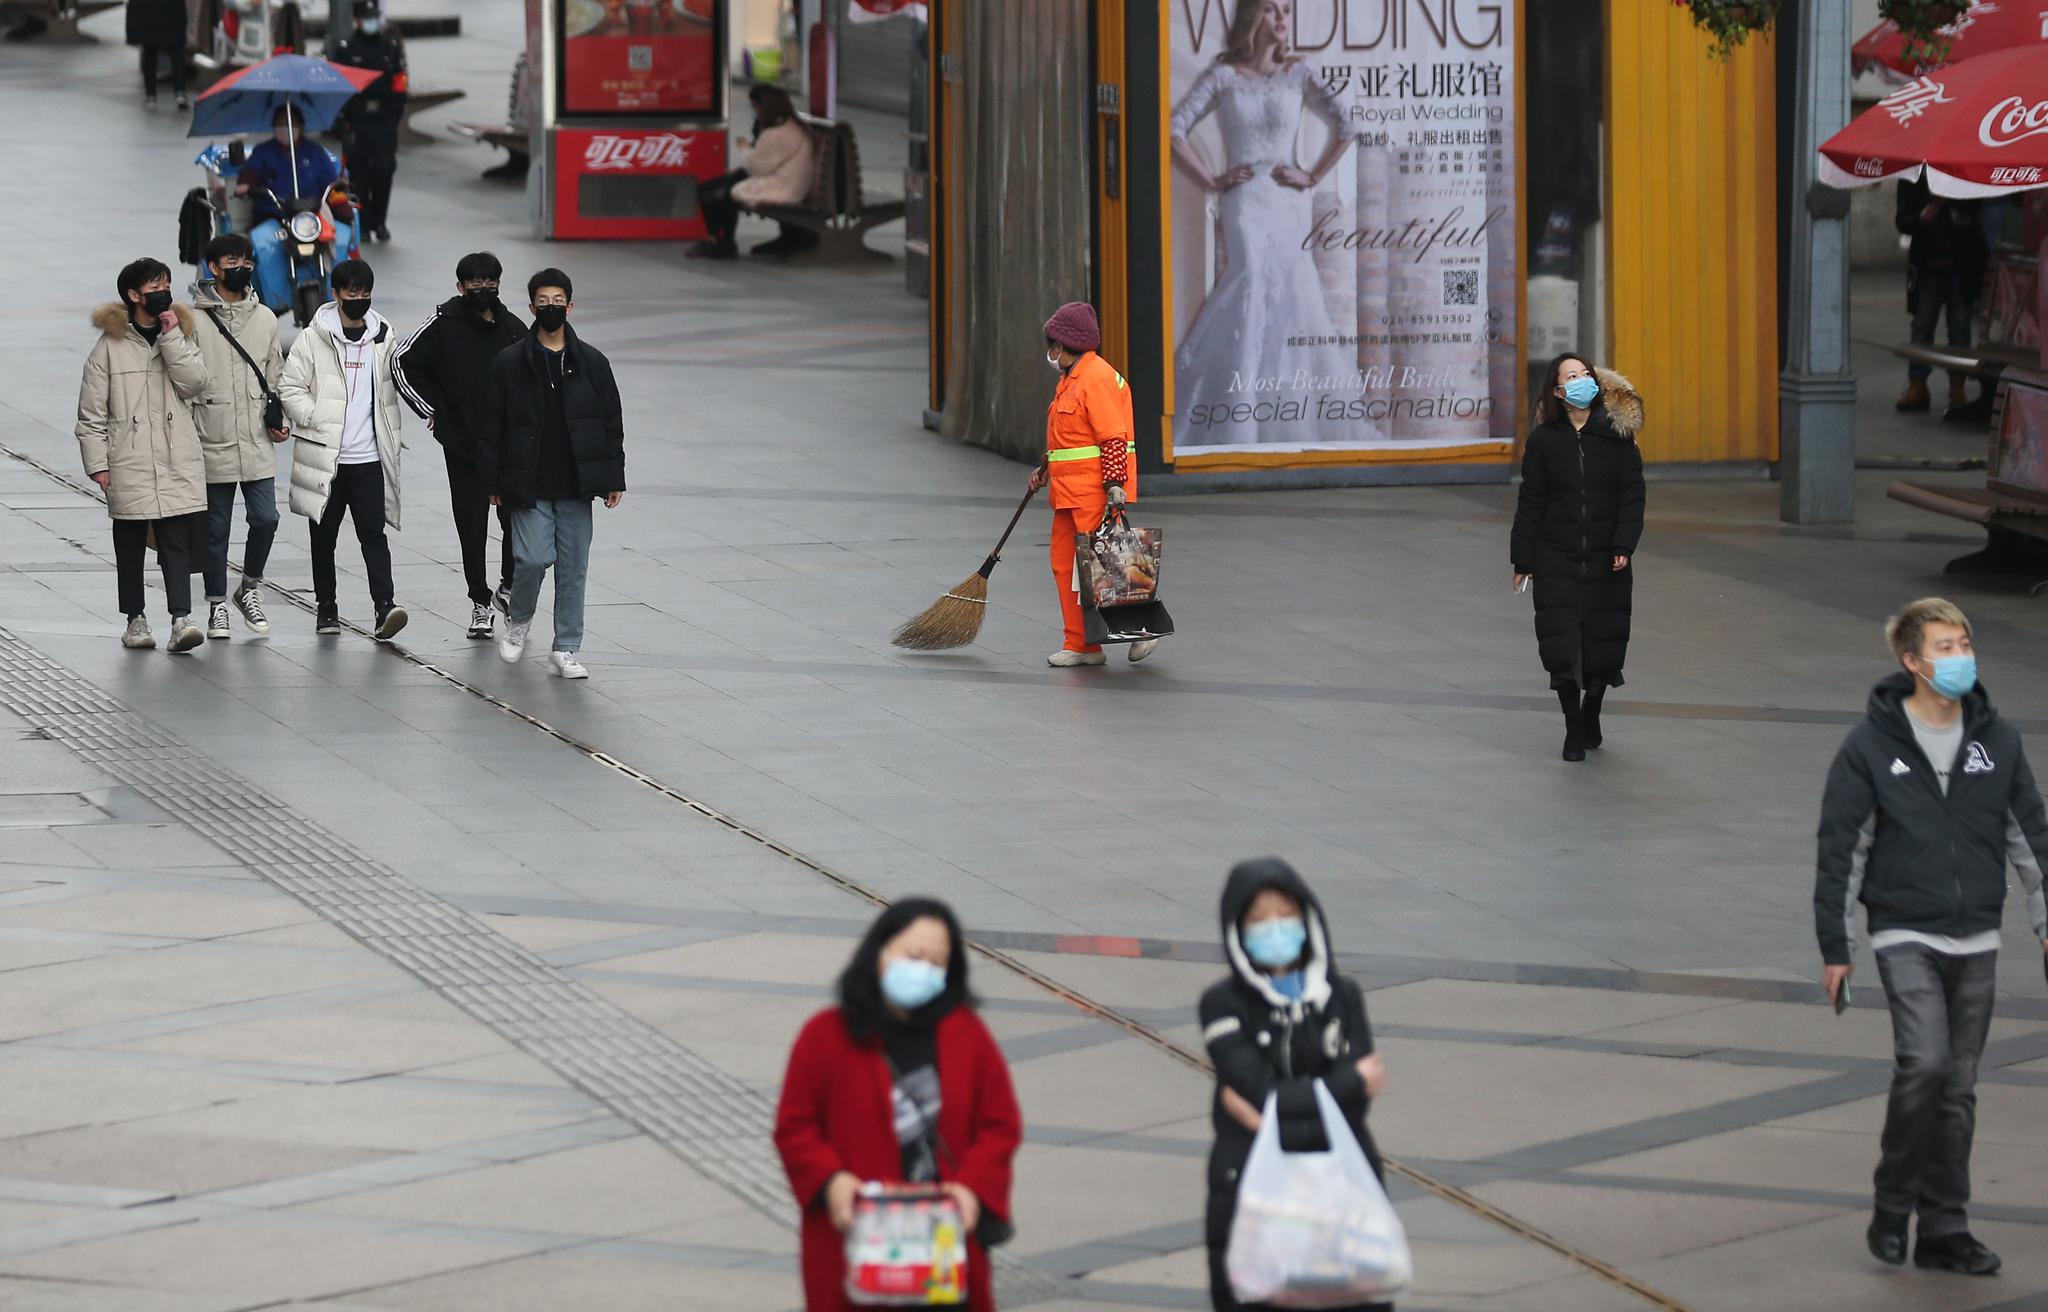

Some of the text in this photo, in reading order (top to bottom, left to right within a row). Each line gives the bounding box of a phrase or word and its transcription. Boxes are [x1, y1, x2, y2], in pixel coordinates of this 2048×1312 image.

[1182, 0, 1503, 54] WDDING
[1320, 61, 1504, 100] 罗亚礼服馆
[1350, 103, 1503, 124] Royal Wedding
[584, 133, 696, 169] 可口可乐
[1990, 166, 2043, 184] 可口可乐
[1301, 205, 1508, 264] beautiful
[1227, 370, 1284, 394] Most
[1292, 365, 1395, 395] Beautiful
[1190, 391, 1497, 428] special fascination
